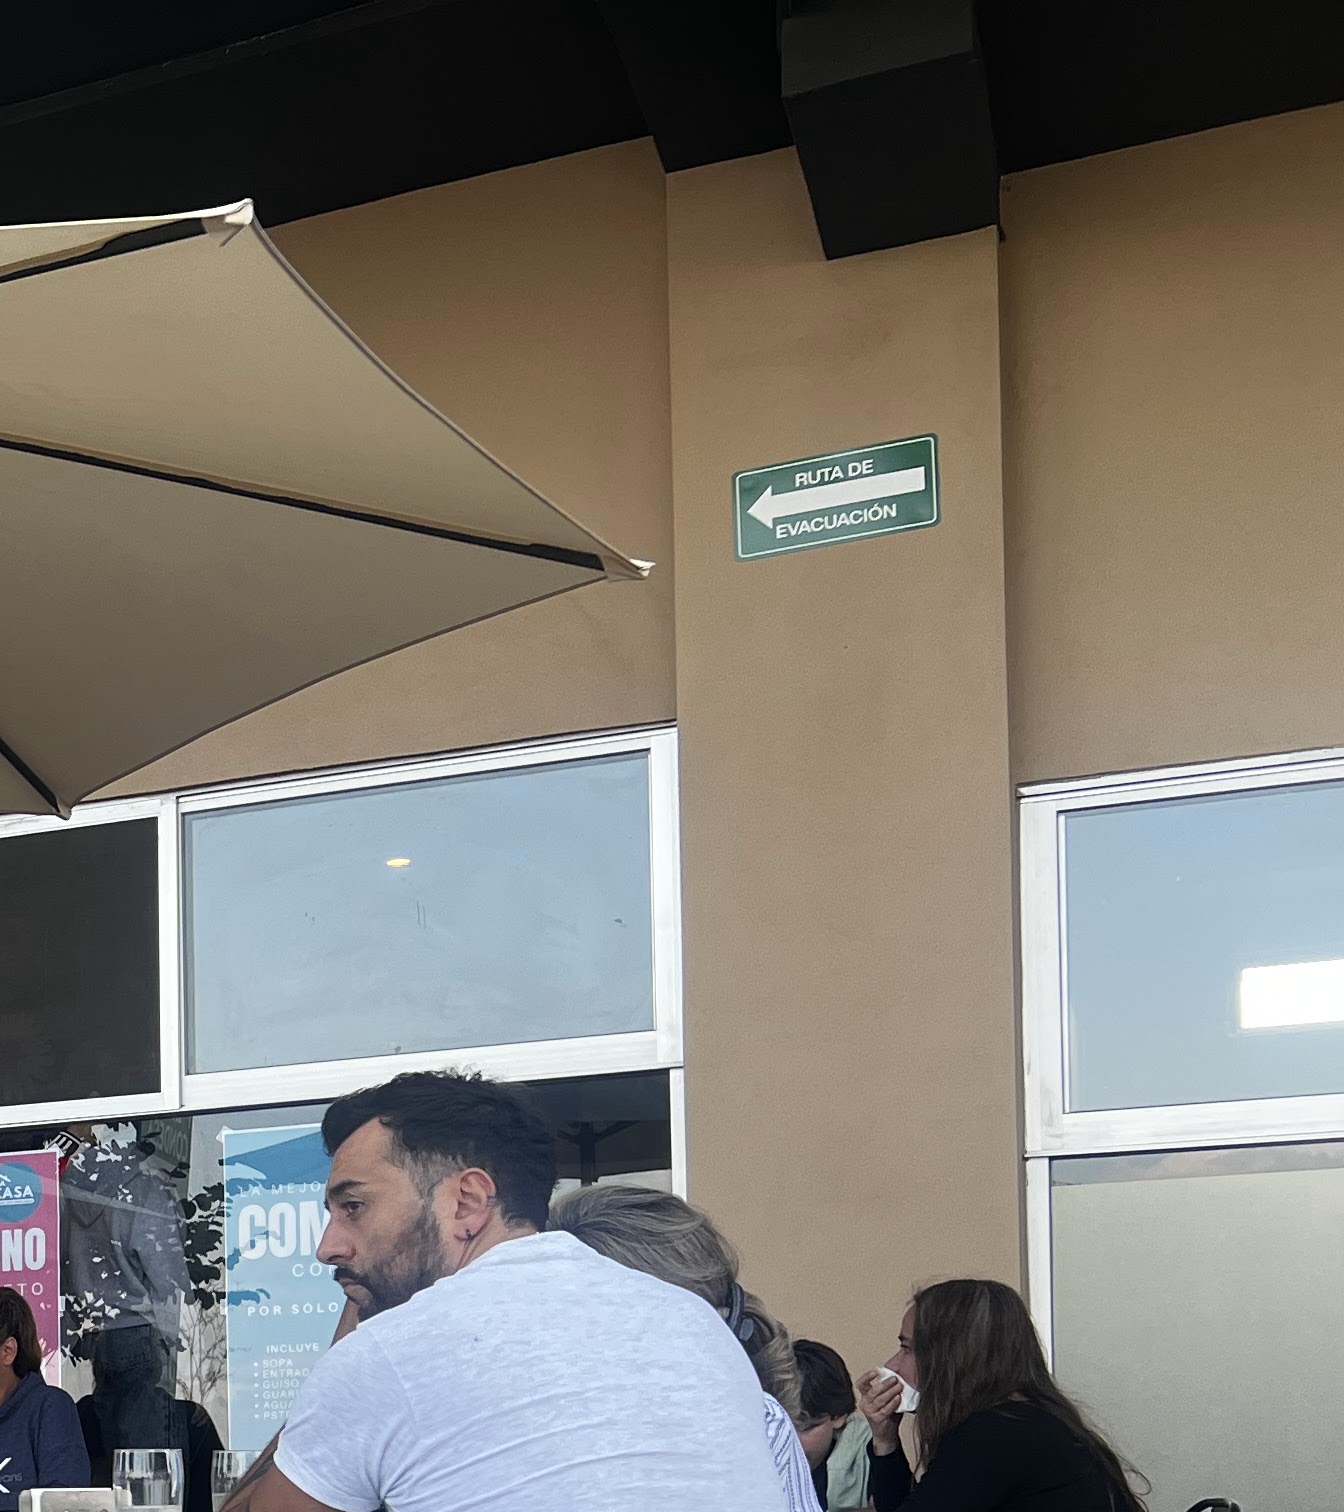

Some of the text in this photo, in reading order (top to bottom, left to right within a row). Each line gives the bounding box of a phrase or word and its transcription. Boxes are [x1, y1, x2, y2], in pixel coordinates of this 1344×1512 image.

[795, 459, 874, 487] RUTA DE
[775, 503, 897, 539] EVACUACIÓN
[272, 1181, 328, 1195] MEJO
[247, 1305, 282, 1317] POR
[266, 1342, 320, 1354] INCLUYE
[262, 1358, 293, 1369] SOPA
[262, 1368, 311, 1379] ENTRAD
[262, 1379, 300, 1390] GUISO
